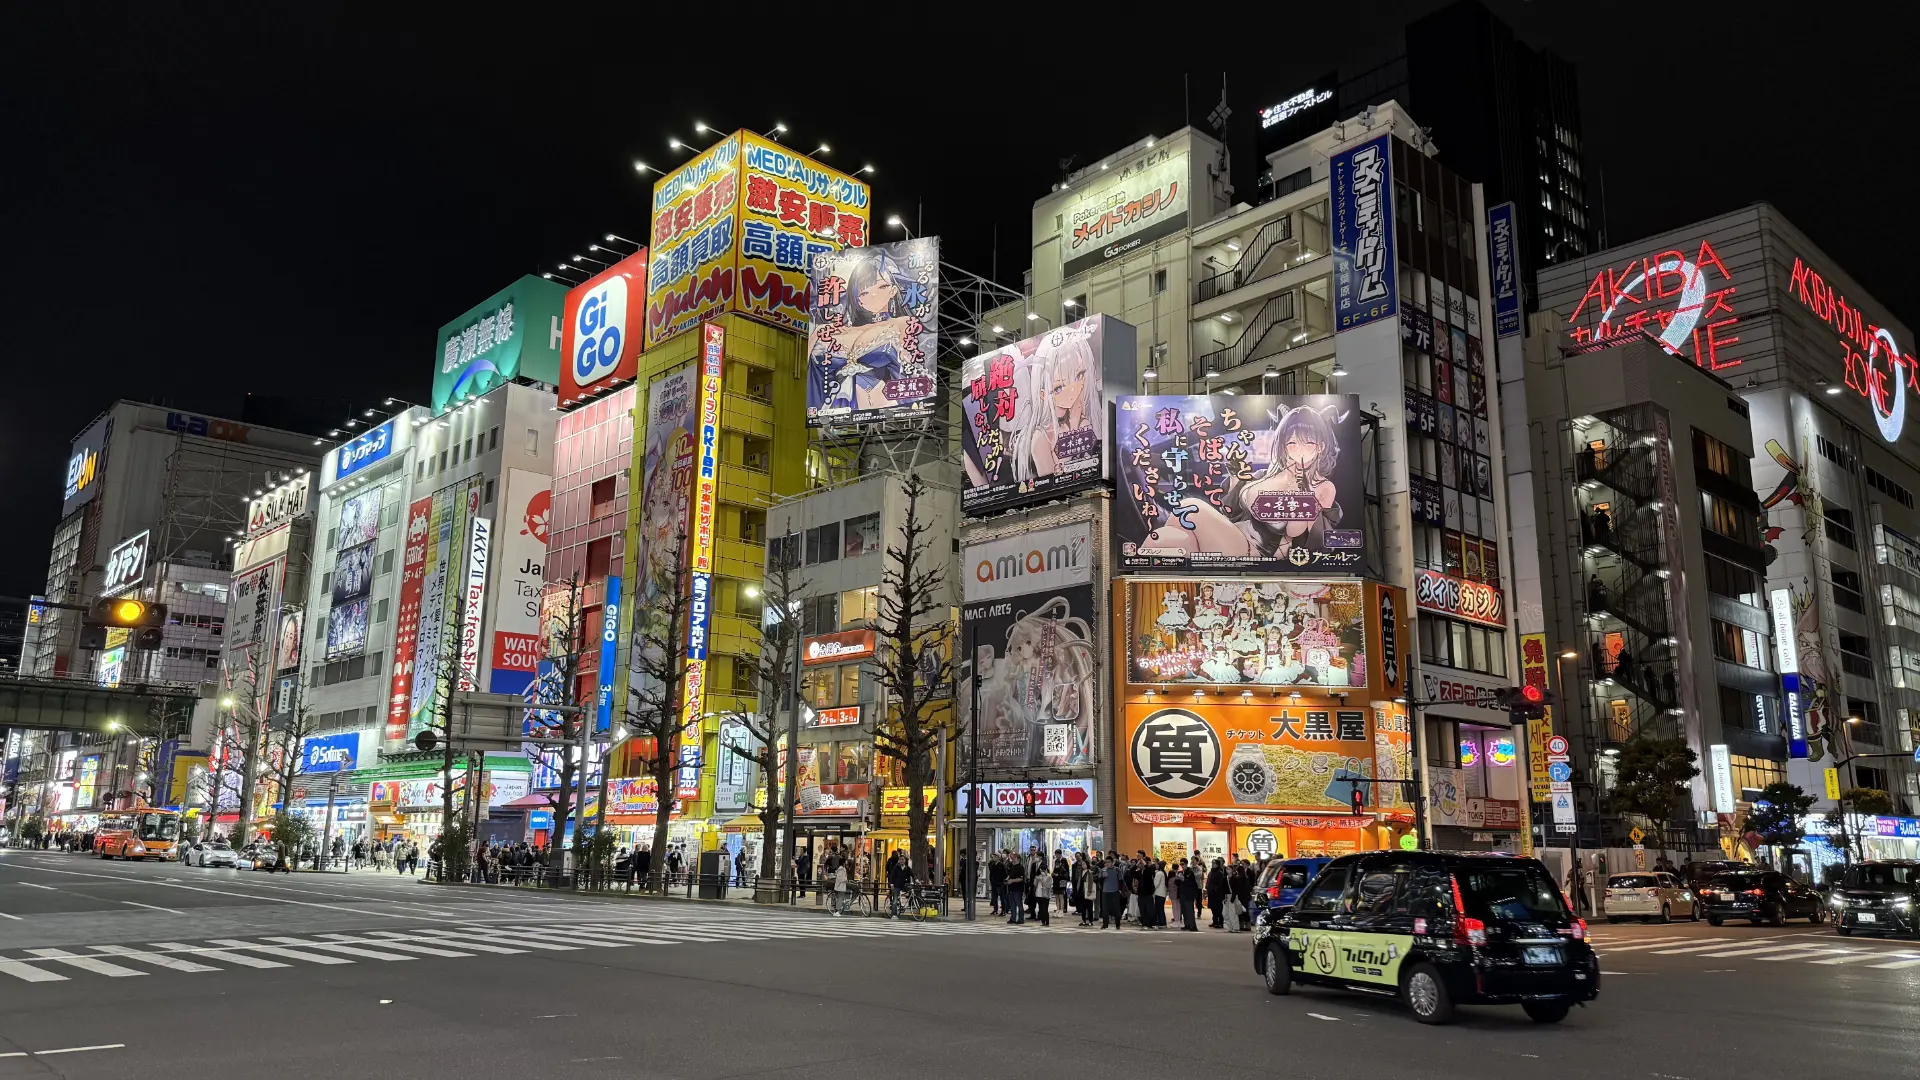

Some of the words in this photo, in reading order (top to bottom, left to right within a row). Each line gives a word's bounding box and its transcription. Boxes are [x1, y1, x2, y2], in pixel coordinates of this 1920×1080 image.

[1262, 90, 1333, 129] 秋葉原ファーストビル
[1273, 89, 1315, 115] 住友不動産
[655, 138, 738, 211] MEDIAリサイクル
[747, 143, 868, 208] MEDIAリサイクル
[654, 171, 736, 249] 激安販売
[746, 174, 865, 247] 激安販売
[1072, 181, 1178, 249] メイドカジノ
[651, 217, 733, 294] 高額買取
[743, 220, 831, 277] 高額買
[649, 266, 734, 341] Mulan
[1338, 261, 1350, 310] 秋葉原店
[1569, 240, 1731, 323] AKIBA
[1416, 329, 1431, 350] 7F
[971, 375, 992, 433] 屈しない
[988, 354, 1019, 422] 絶対
[1221, 408, 1255, 480] ちゃんと
[1420, 413, 1435, 432] 6F
[351, 432, 387, 464] ソフマップ
[1155, 407, 1199, 530] 私に守らせて
[1190, 416, 1232, 514] そばにいて、
[287, 486, 307, 517] HAT
[1426, 500, 1440, 520] 5F
[474, 521, 488, 569] AKKY
[520, 559, 545, 577] Ja
[977, 542, 1077, 582] amiami
[1312, 551, 1361, 564] アズールレーン
[514, 580, 542, 598] Tax
[989, 603, 1012, 618] ARTS
[1417, 573, 1502, 620] メイドカジノ
[1227, 729, 1265, 740] チケット
[1270, 710, 1368, 741] 大黒屋
[1788, 692, 1800, 739] GALLERIA
[682, 746, 698, 755] 2F
[1143, 723, 1213, 788] 質
[1530, 722, 1542, 772] 세점
[1552, 742, 1564, 750] 40
[997, 790, 1042, 805] COMC
[1044, 790, 1064, 805] ZIN
[1468, 811, 1484, 820] TOKIS
[1251, 834, 1274, 853] 質
